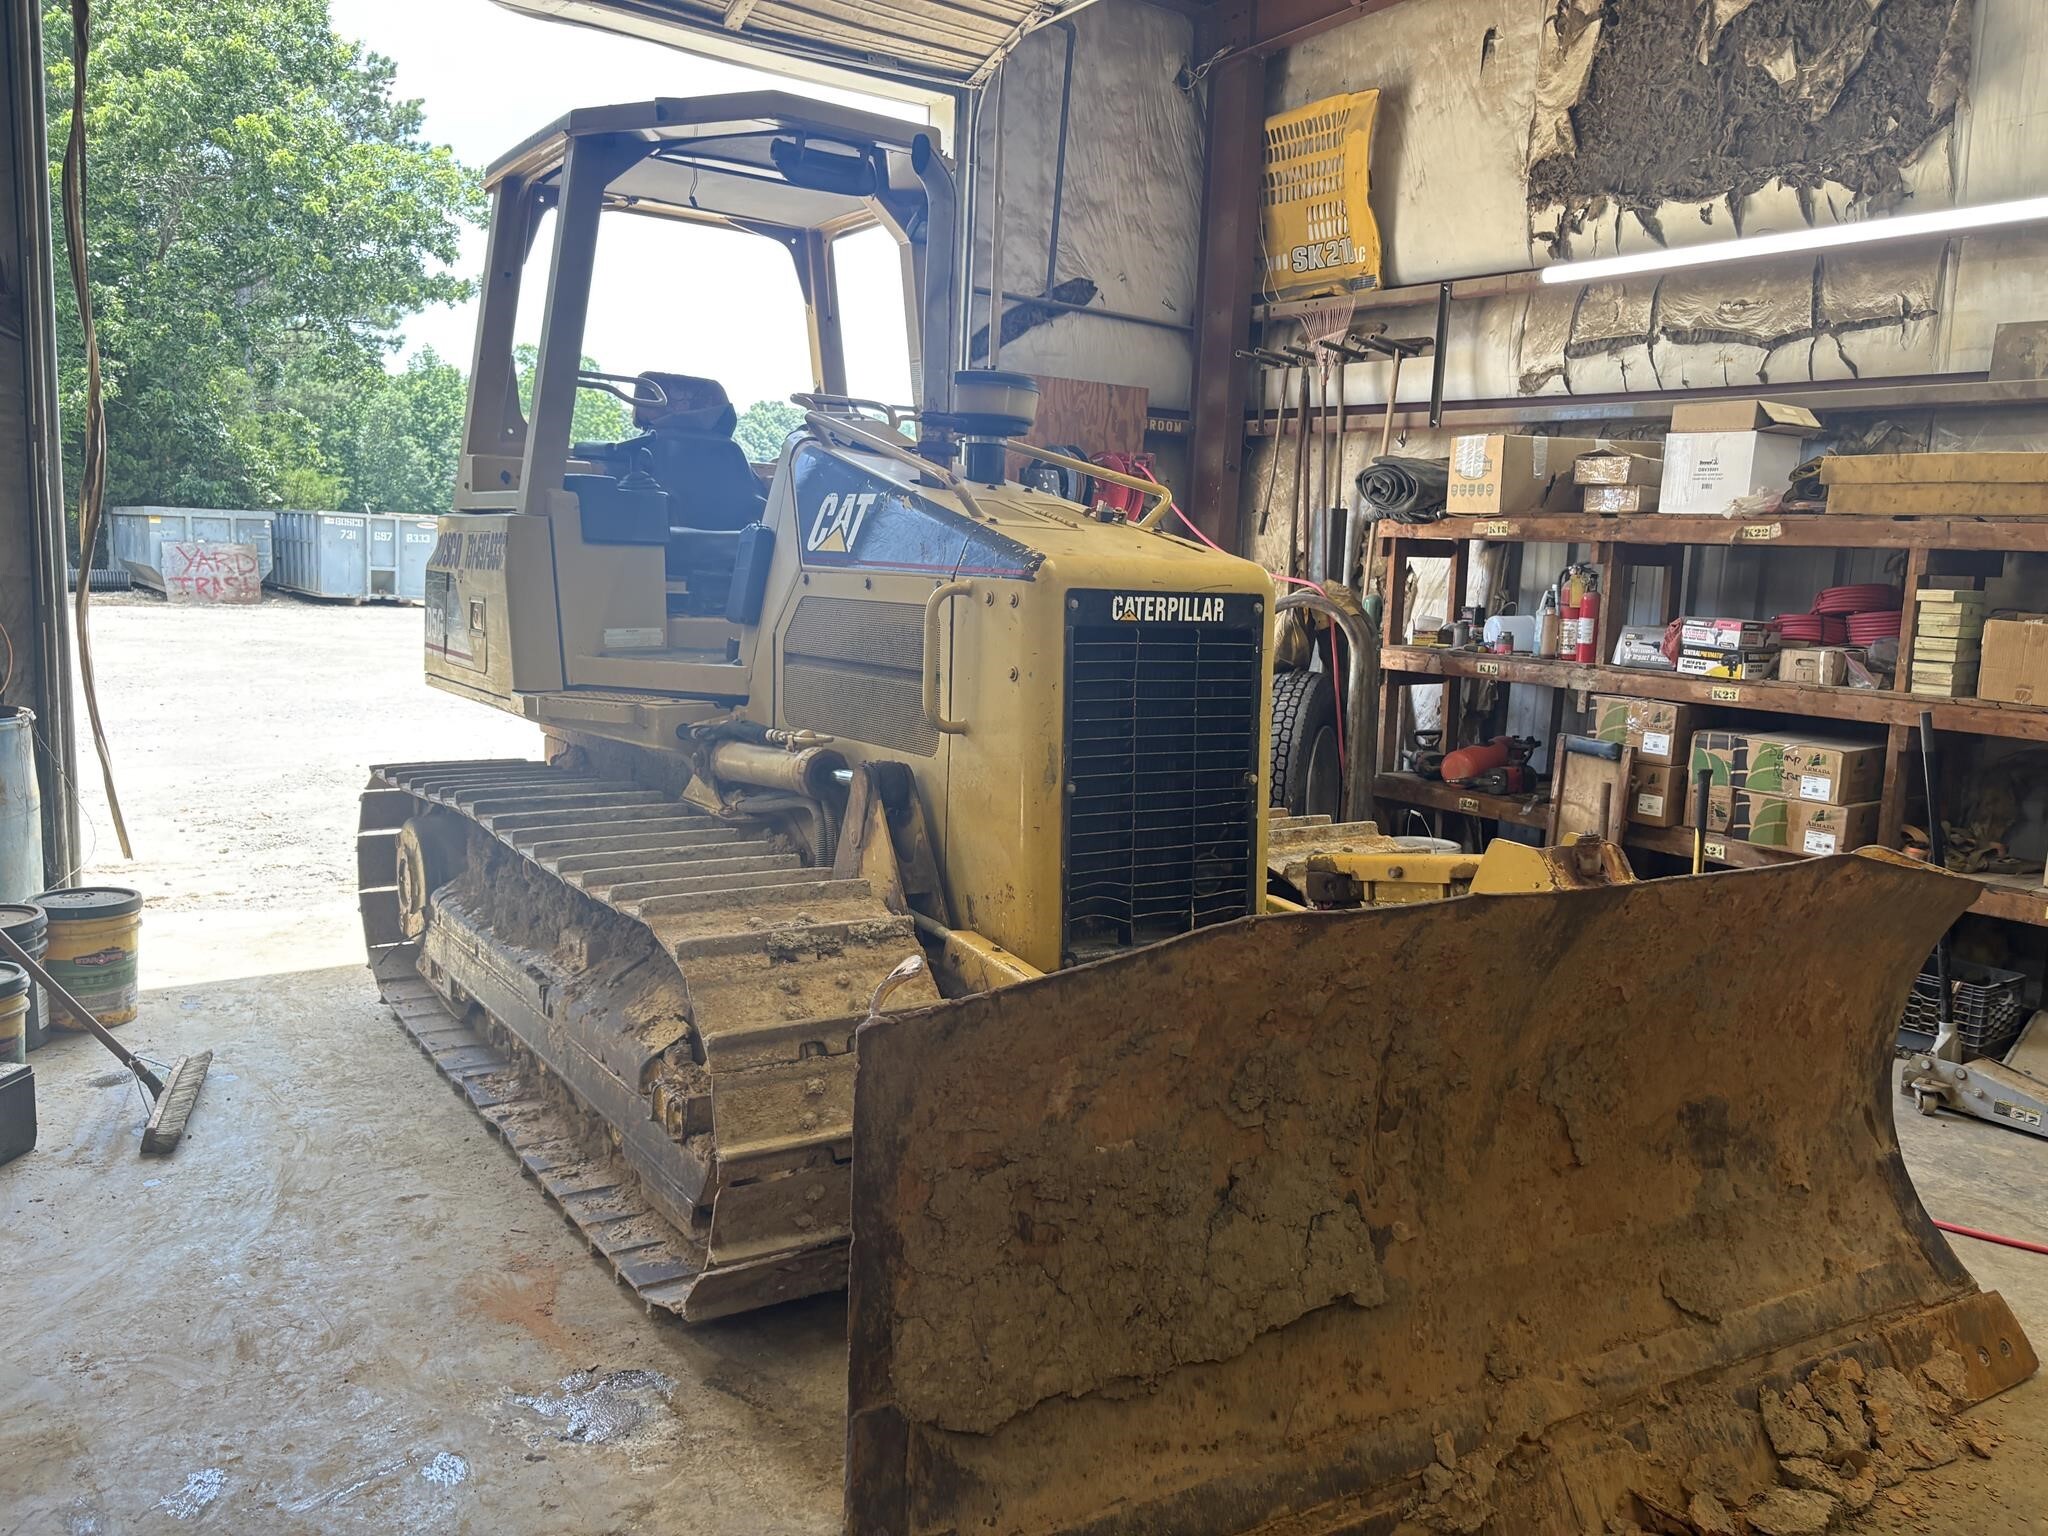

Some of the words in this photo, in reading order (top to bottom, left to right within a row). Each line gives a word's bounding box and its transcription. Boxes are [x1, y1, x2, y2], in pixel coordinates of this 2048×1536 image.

[807, 492, 877, 553] CAT
[340, 529, 357, 540] 731
[1489, 525, 1508, 534] K18
[1744, 528, 1769, 538] K22
[176, 545, 257, 576] YARD
[1112, 596, 1225, 622] CATERPILLAR
[1479, 664, 1497, 673] K19
[1713, 690, 1736, 700] K23
[1803, 765, 1831, 775] ARMADA
[1806, 820, 1836, 831] ARMADA
